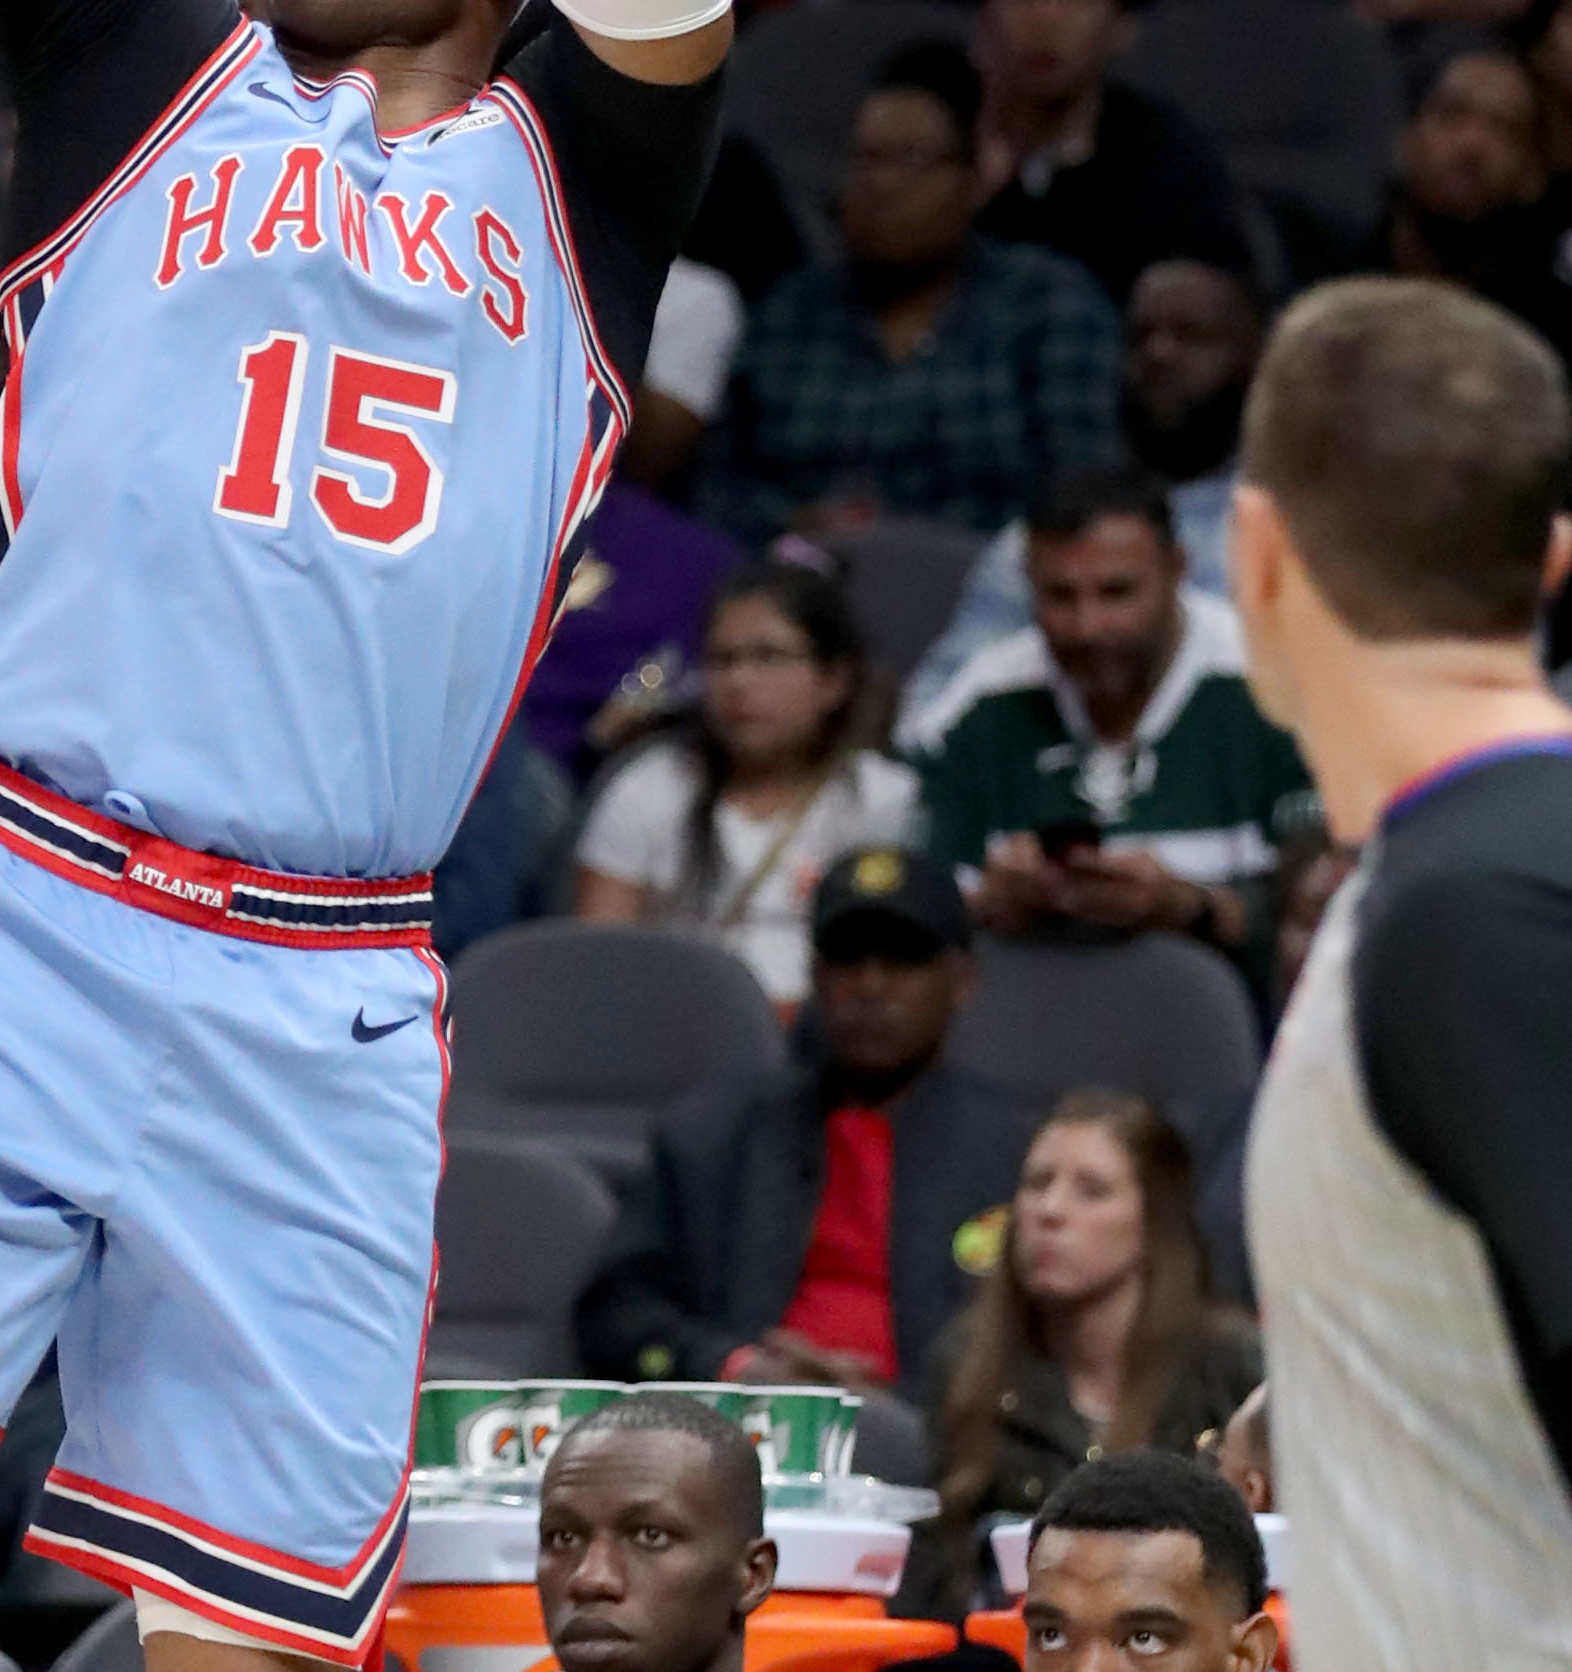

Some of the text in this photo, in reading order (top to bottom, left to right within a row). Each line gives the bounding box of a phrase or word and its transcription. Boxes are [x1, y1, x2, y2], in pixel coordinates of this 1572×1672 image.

[154, 143, 529, 346] HAWKS
[212, 329, 457, 556] 15
[128, 862, 224, 909] ATLANTA
